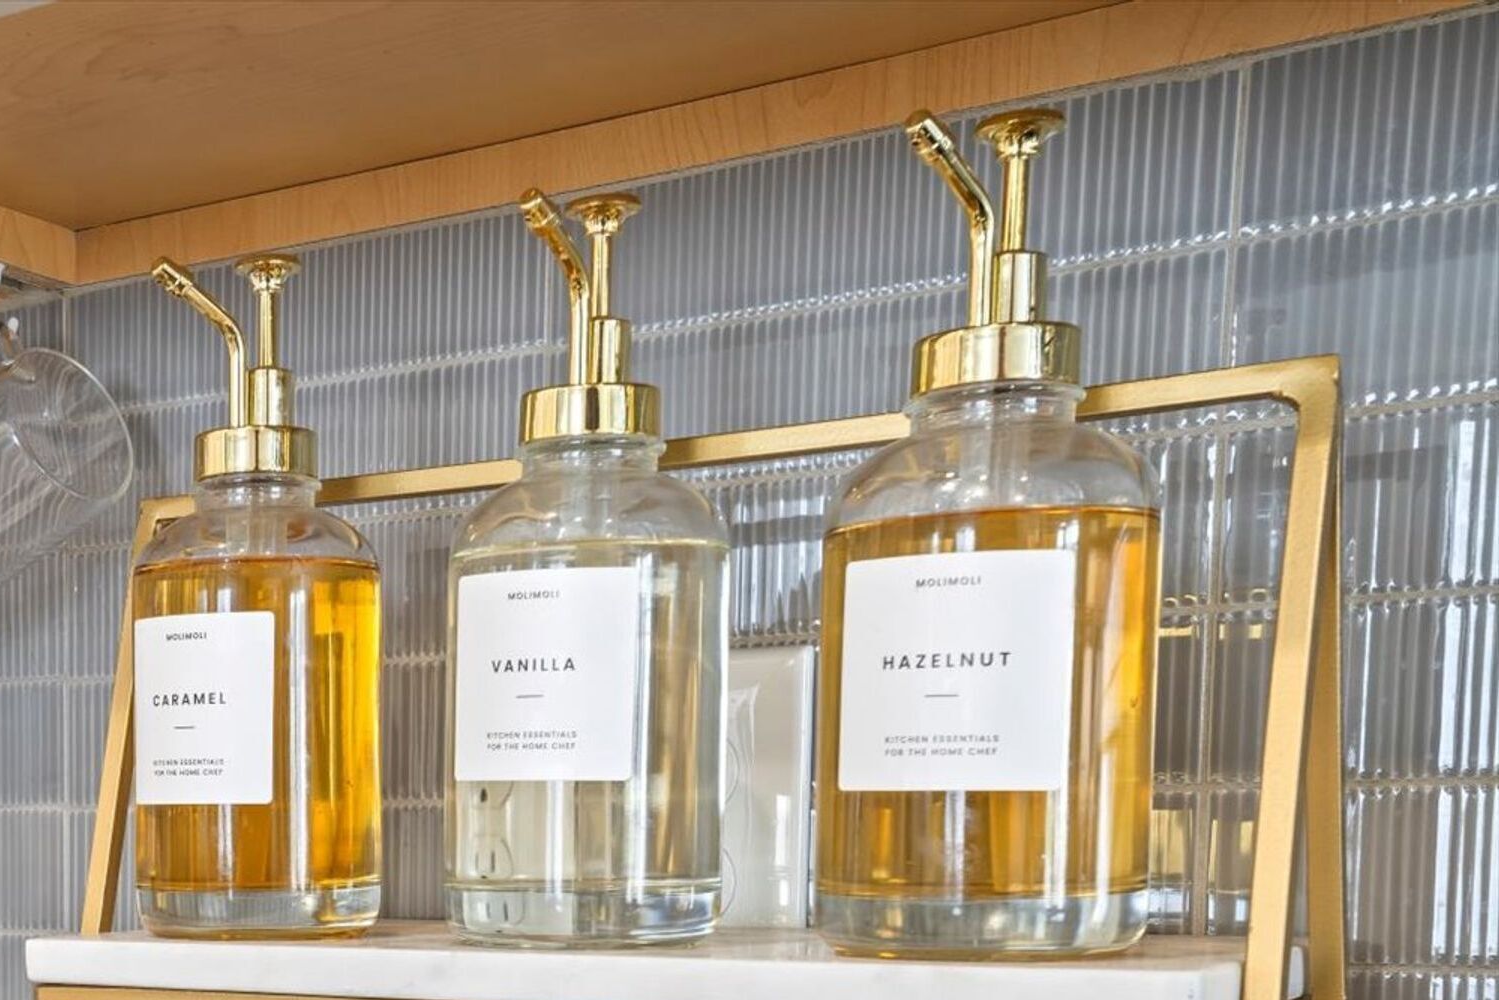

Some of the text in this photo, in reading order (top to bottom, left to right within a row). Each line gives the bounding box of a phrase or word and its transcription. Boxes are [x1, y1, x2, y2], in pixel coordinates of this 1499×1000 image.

[914, 576, 982, 588] MOLIMOLI
[507, 590, 561, 601] MOLIMOLI
[165, 631, 208, 642] MOLIMOLI
[491, 656, 577, 674] VANILLA
[882, 651, 1013, 670] HAZELNUT
[152, 691, 227, 708] CARAMEL
[486, 729, 578, 740] KITCHEN ESSENTIALS
[884, 733, 1000, 744] KITCHEN ESSENTIALS
[486, 741, 576, 751] FOR THE HOME CHEF
[884, 746, 998, 757] FOR THE HOME CHEF
